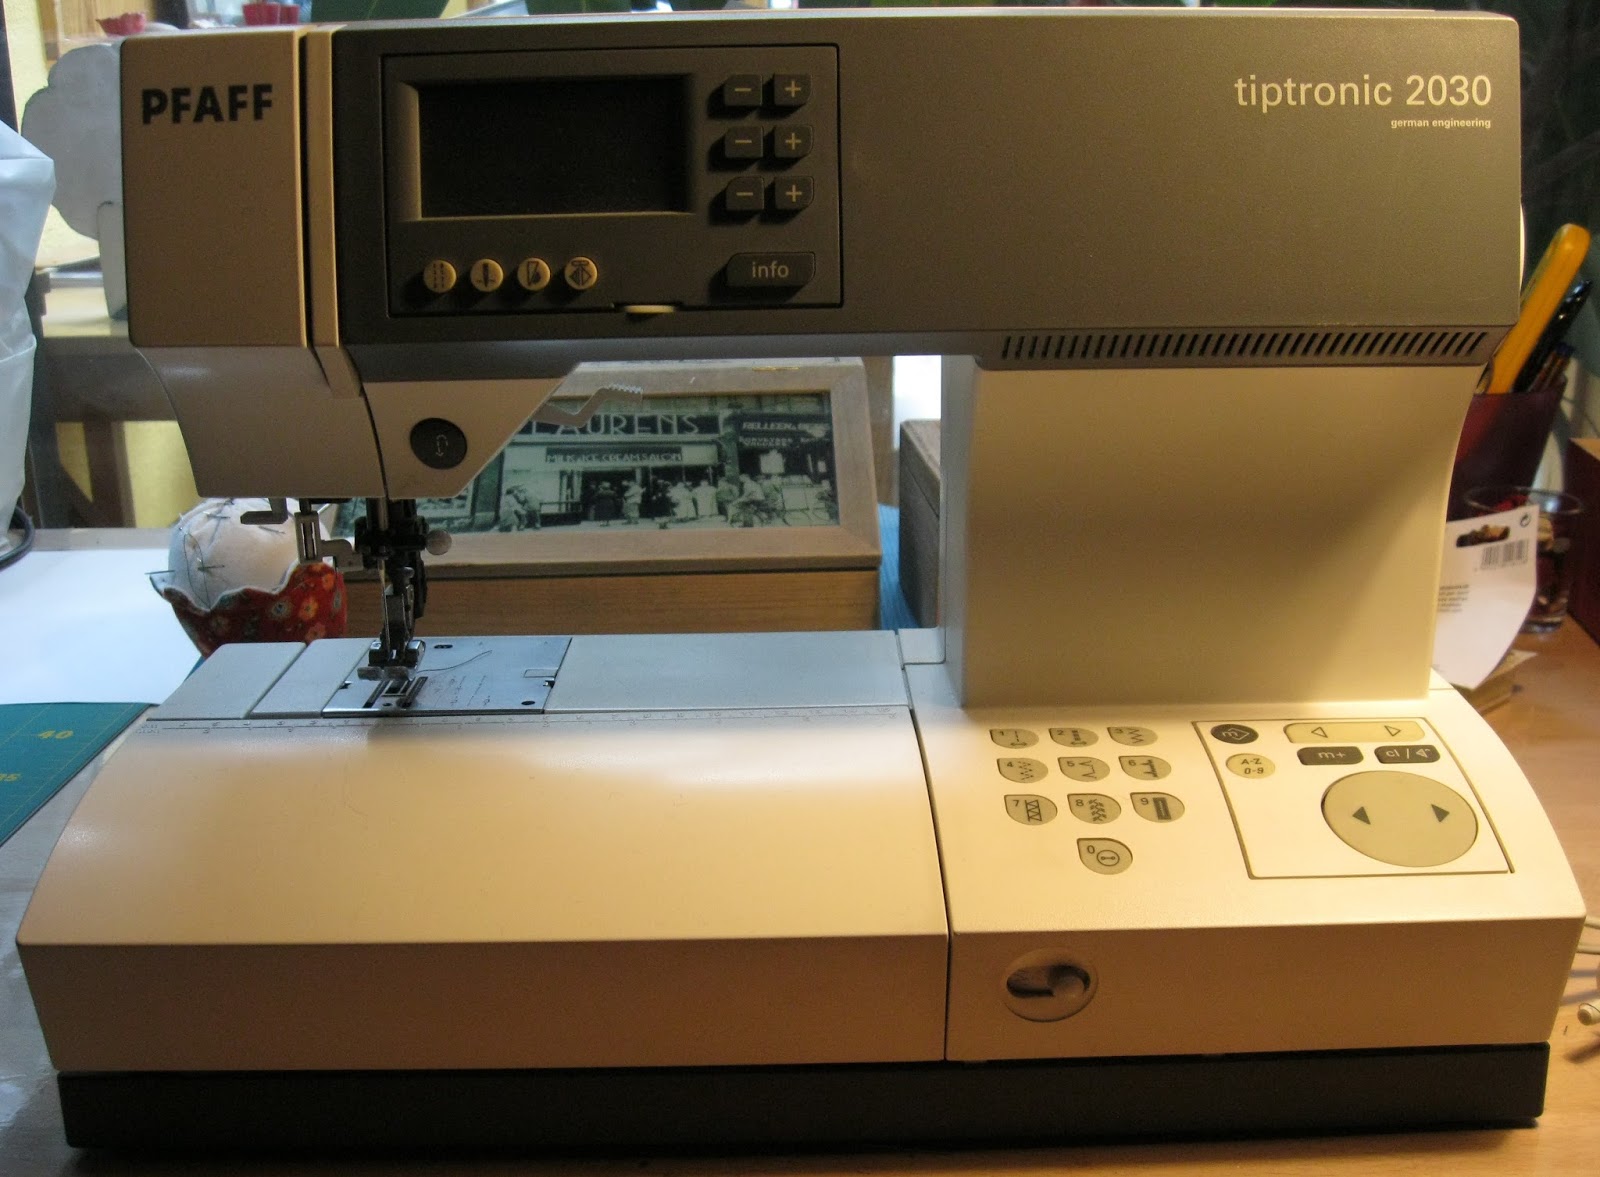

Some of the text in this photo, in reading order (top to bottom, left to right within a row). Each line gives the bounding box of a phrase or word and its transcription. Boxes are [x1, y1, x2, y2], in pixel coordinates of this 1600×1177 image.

[1234, 74, 1492, 114] tiptronic 2030
[141, 83, 274, 125] PFAFF
[1390, 117, 1493, 129] german engineering
[751, 260, 790, 279] info
[37, 729, 74, 740] 40
[1128, 759, 1137, 767] 6
[1012, 799, 1020, 807] 7
[1075, 799, 1085, 807] 8
[1140, 797, 1149, 806] 9
[1086, 844, 1096, 855] 0
